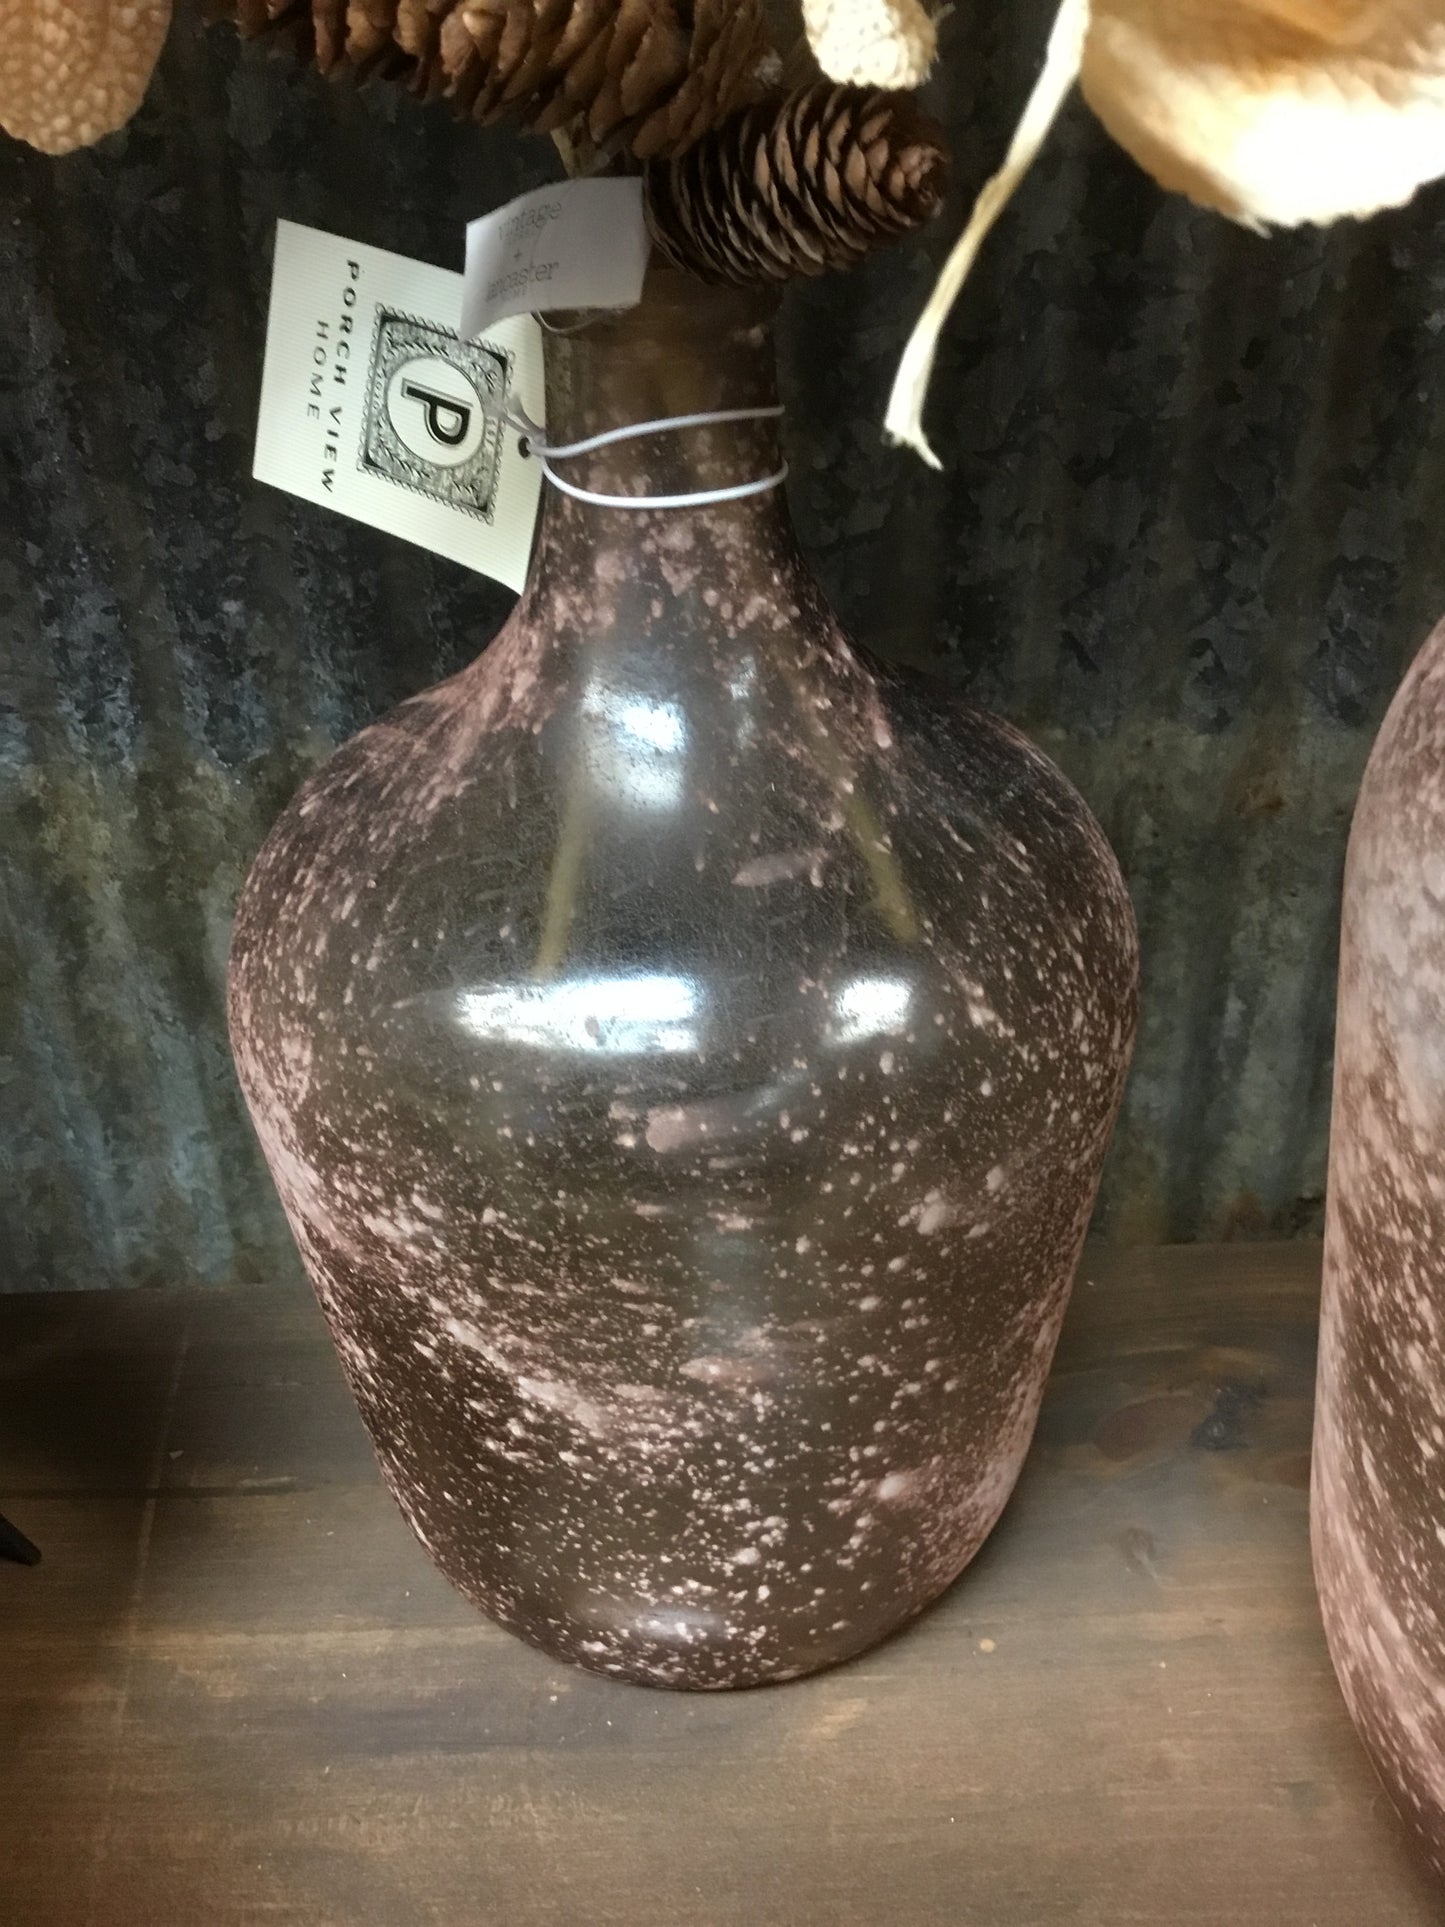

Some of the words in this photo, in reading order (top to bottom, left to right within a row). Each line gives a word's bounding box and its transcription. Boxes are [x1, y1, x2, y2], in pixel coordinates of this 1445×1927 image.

[333, 259, 360, 385] PORCH
[306, 319, 330, 420] HOME
[401, 376, 474, 448] P
[321, 405, 343, 493] VIEW
